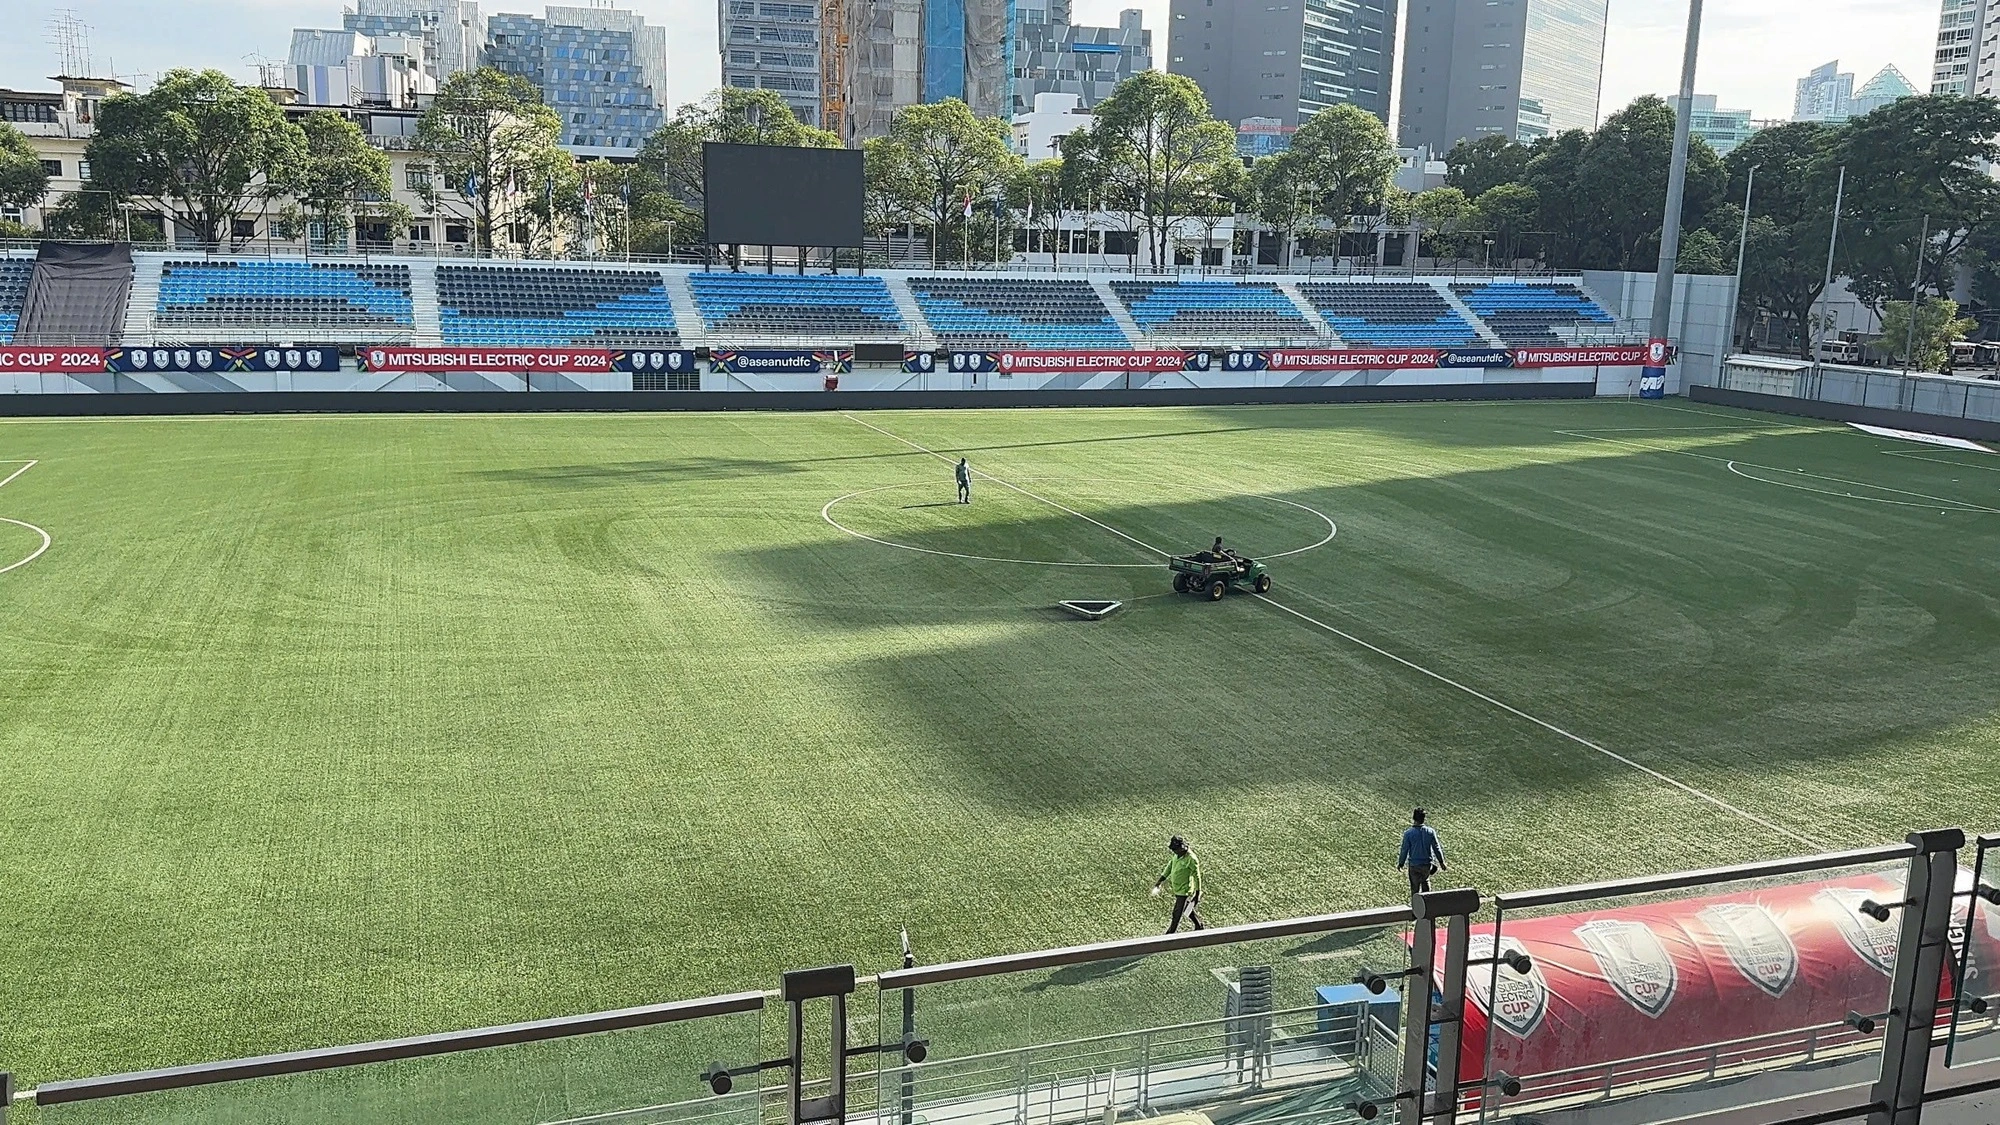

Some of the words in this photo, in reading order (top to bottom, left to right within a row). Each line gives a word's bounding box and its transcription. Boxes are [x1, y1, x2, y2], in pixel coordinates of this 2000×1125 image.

[18, 353, 55, 366] CUP
[61, 353, 100, 366] 2024
[388, 353, 467, 366] MITSUBISHI
[469, 353, 535, 366] ELECTRIC
[538, 353, 569, 366] CUP
[573, 354, 606, 367] 2024
[737, 355, 811, 368] @aseanutdfc
[1015, 355, 1075, 368] MITSUBISHI
[1076, 355, 1127, 367] ELECTRIC
[1128, 355, 1150, 367] CUP
[1155, 355, 1181, 367] 2024
[1283, 354, 1337, 366] MITSUBISHI
[1338, 354, 1385, 365] ELECTRIC
[1386, 354, 1408, 365] CUP
[1411, 353, 1435, 365] 2024
[1448, 353, 1504, 364] @aseanutdfc
[1528, 352, 1577, 363] MITSUBISHI
[1577, 351, 1620, 362] ELECTRIC
[1621, 351, 1641, 361] CUP
[1861, 934, 1898, 948] ELECTRIC
[1873, 944, 1896, 956] CUP
[1757, 962, 1782, 975] CUP
[1624, 971, 1664, 985] ELECTRIC
[1482, 980, 1535, 995] MSUBISHI
[1634, 982, 1660, 995] CUP
[1494, 989, 1535, 1004] LECTRIC
[1502, 1001, 1530, 1015] CUP
